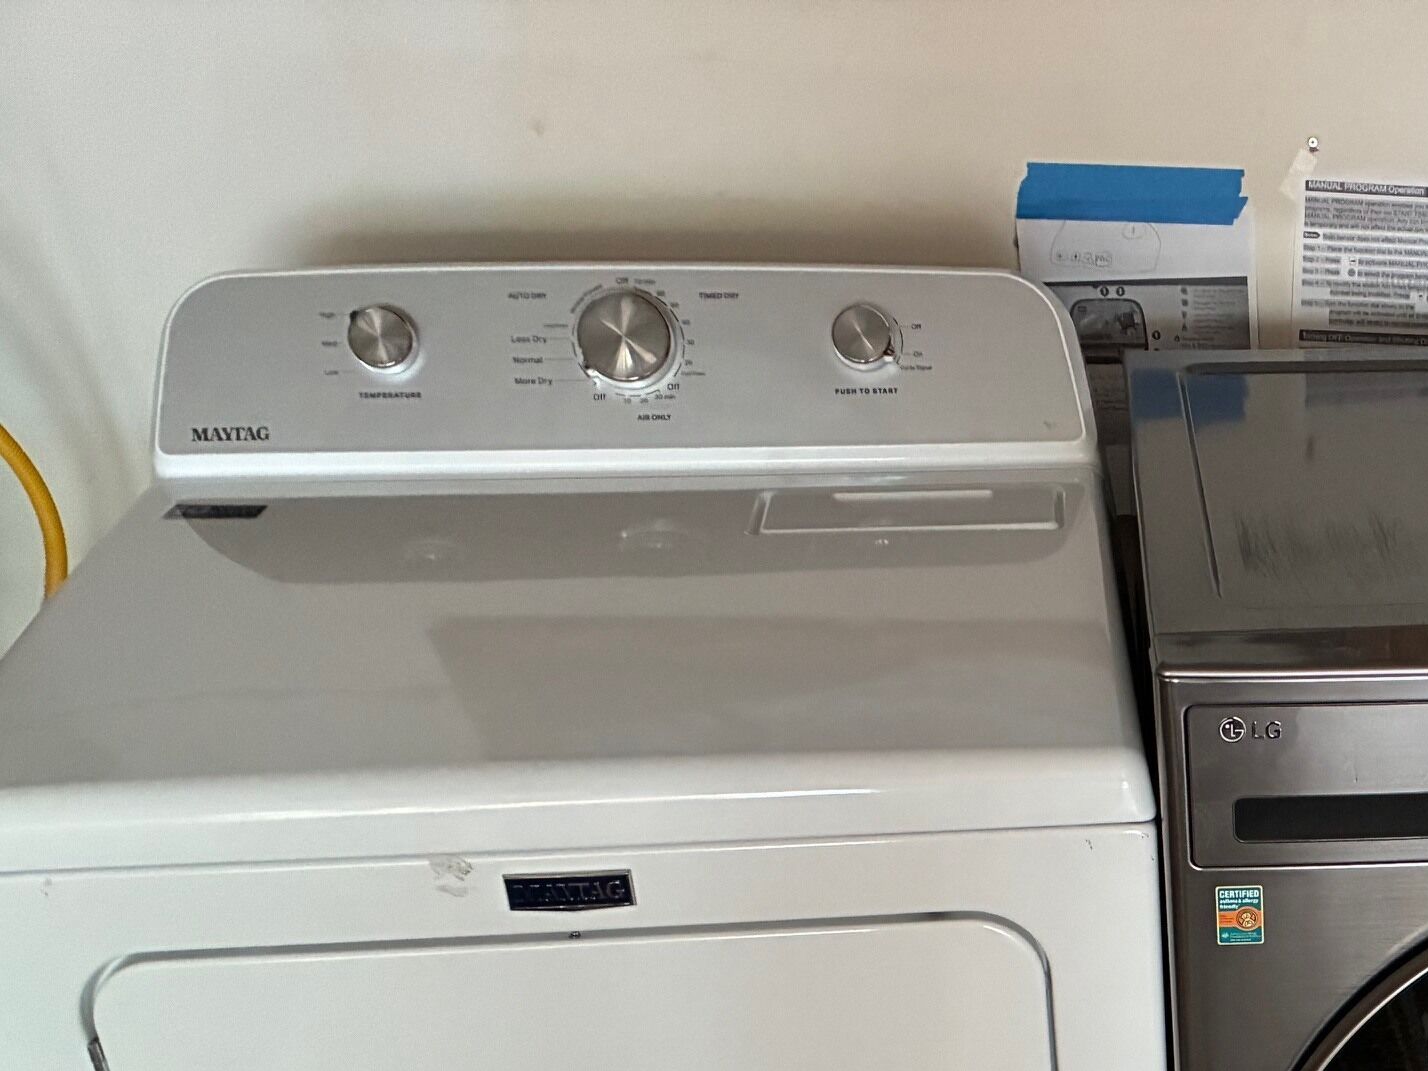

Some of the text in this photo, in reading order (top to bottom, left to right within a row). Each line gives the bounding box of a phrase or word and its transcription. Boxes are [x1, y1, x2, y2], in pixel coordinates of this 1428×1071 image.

[1308, 180, 1425, 196] MANUAL PROGRAM Operation
[511, 335, 547, 345] Less Dry
[512, 356, 544, 364] Normal
[514, 377, 553, 387] More Dry
[667, 383, 680, 391] Off
[359, 391, 422, 399] TEMPERATURE
[873, 387, 898, 395] START
[593, 393, 606, 401] Off
[191, 426, 270, 442] MAYTAG
[1251, 720, 1282, 740] LG
[1219, 889, 1260, 899] CERTIFIED
